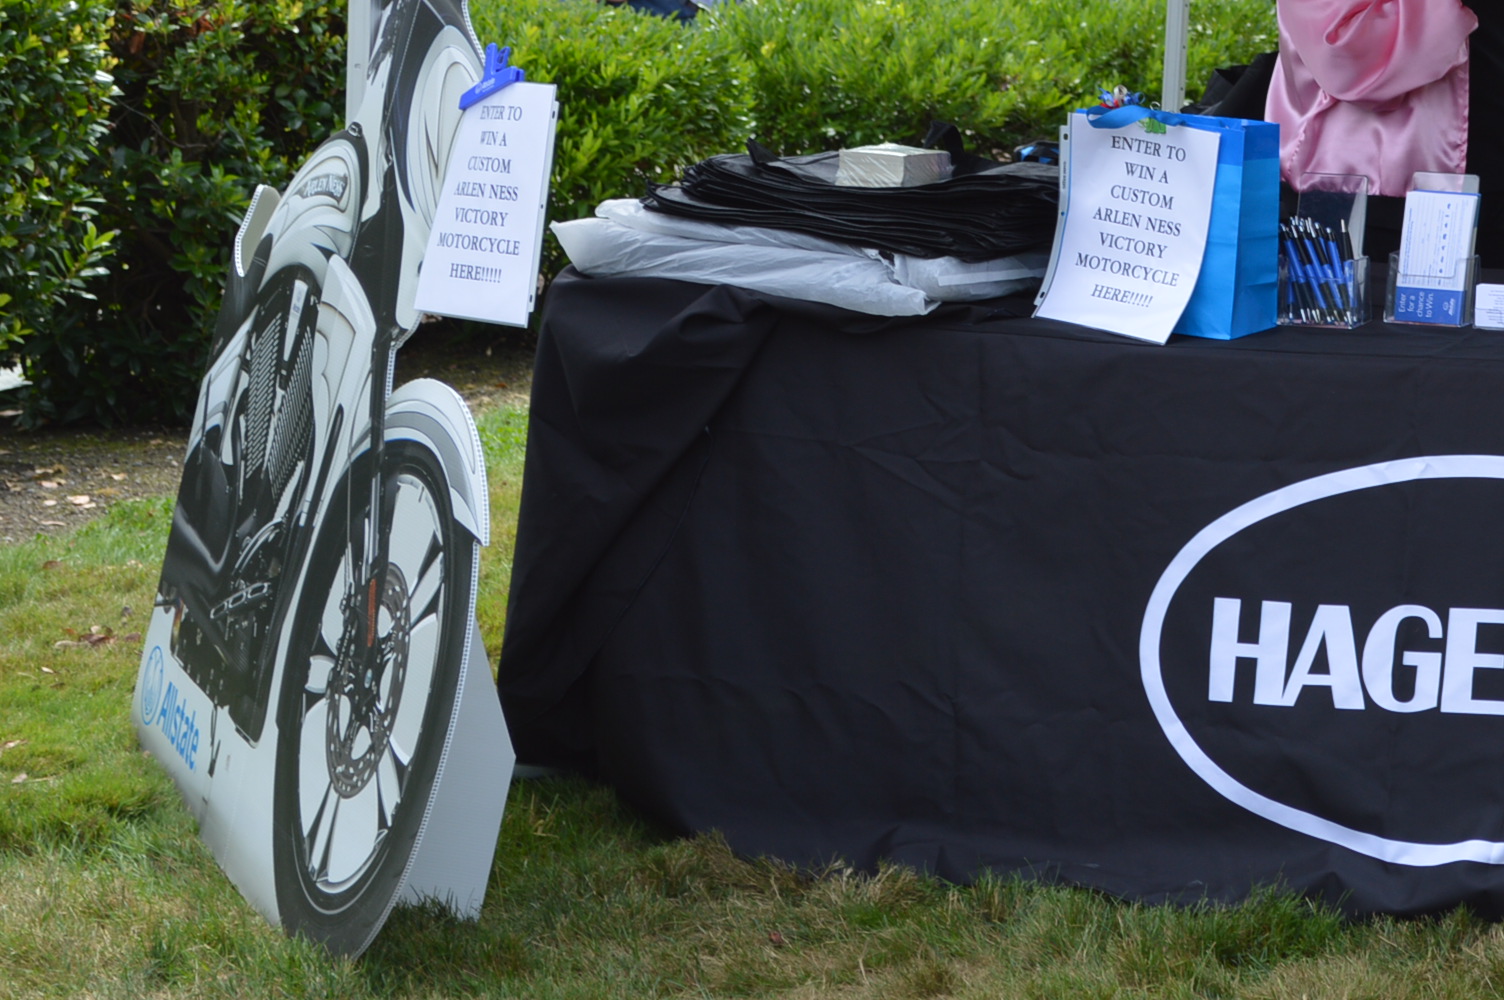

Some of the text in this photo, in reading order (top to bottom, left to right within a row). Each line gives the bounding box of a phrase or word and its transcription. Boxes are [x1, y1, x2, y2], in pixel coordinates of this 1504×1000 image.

[480, 105, 523, 121] ENTER TO
[480, 131, 508, 147] WIN A
[1111, 135, 1187, 162] ENTER TO
[467, 156, 512, 175] CUSTOM
[1125, 161, 1169, 184] WIN A
[454, 182, 518, 202] ARLEN NESS
[1110, 184, 1174, 210] CUSTOM
[455, 207, 508, 227] VICTORY
[1092, 206, 1182, 237] ARLEN NESS
[437, 232, 520, 256] MOTORCYCLE
[1099, 231, 1168, 259] VICTORY
[450, 262, 502, 283] HERE!!!!!
[1075, 252, 1180, 287] MOTORCYCLE
[1091, 284, 1153, 308] HERE!!!!!
[1398, 293, 1407, 313] Enter
[1416, 291, 1425, 317] chance
[157, 681, 199, 770] Allstate
